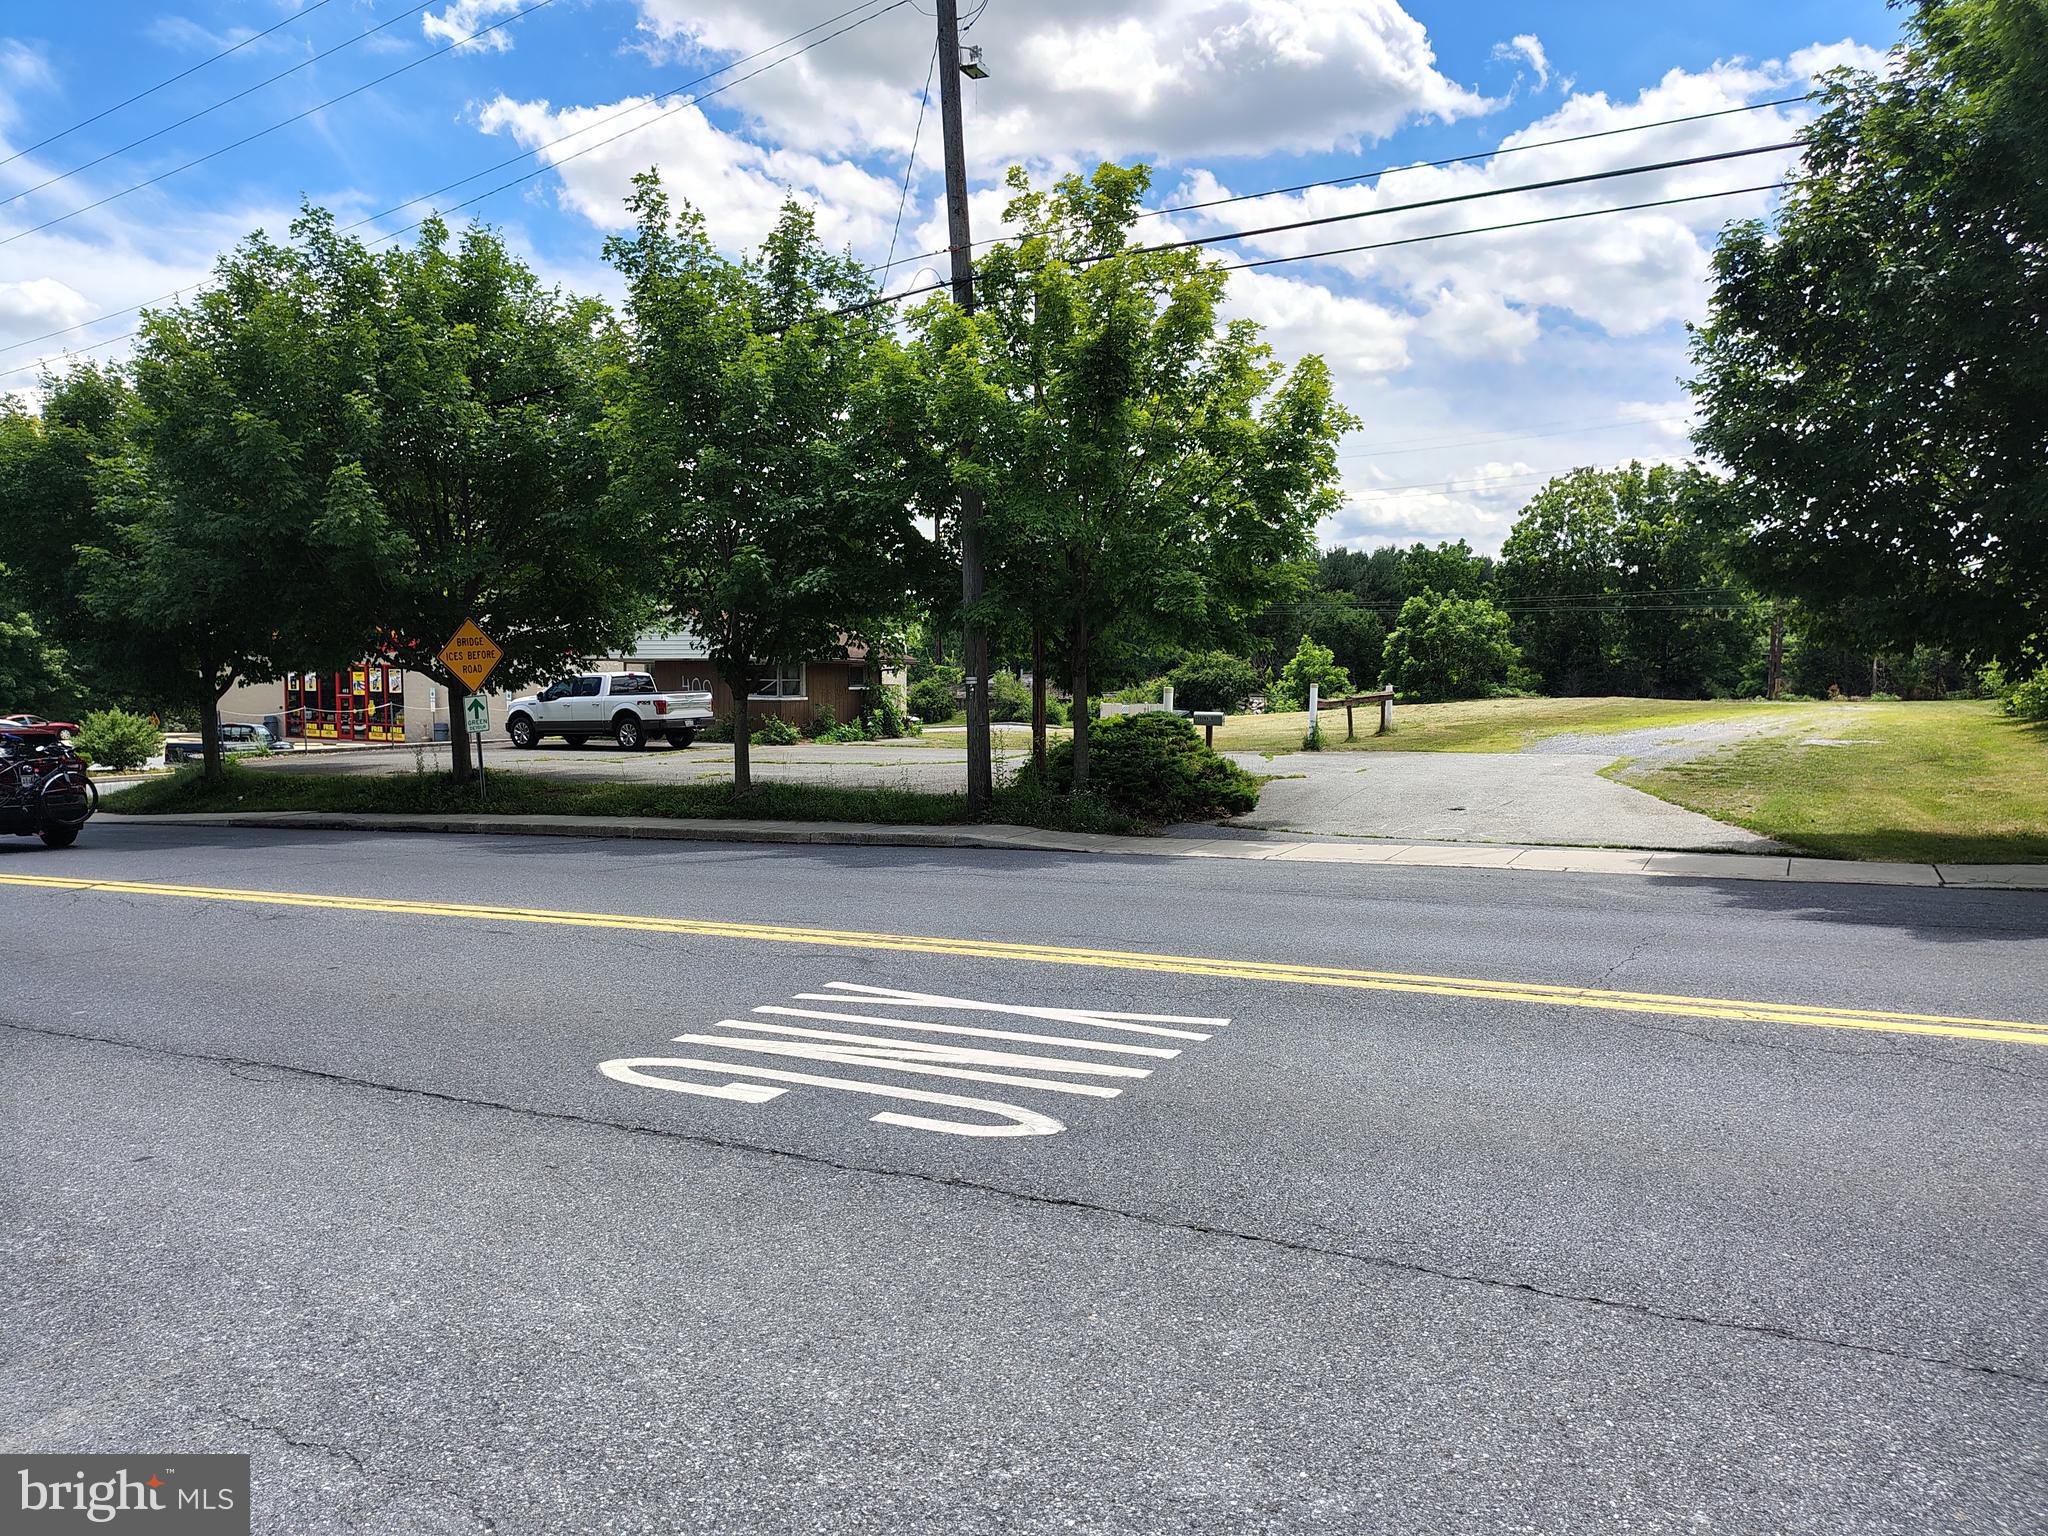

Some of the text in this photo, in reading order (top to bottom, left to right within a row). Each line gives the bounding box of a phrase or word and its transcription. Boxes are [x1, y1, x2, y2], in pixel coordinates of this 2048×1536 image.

[456, 637, 484, 647] BRIDGE
[445, 650, 497, 662] ICES BEFORE
[462, 664, 483, 674] ROAD
[467, 718, 488, 727] GREEN
